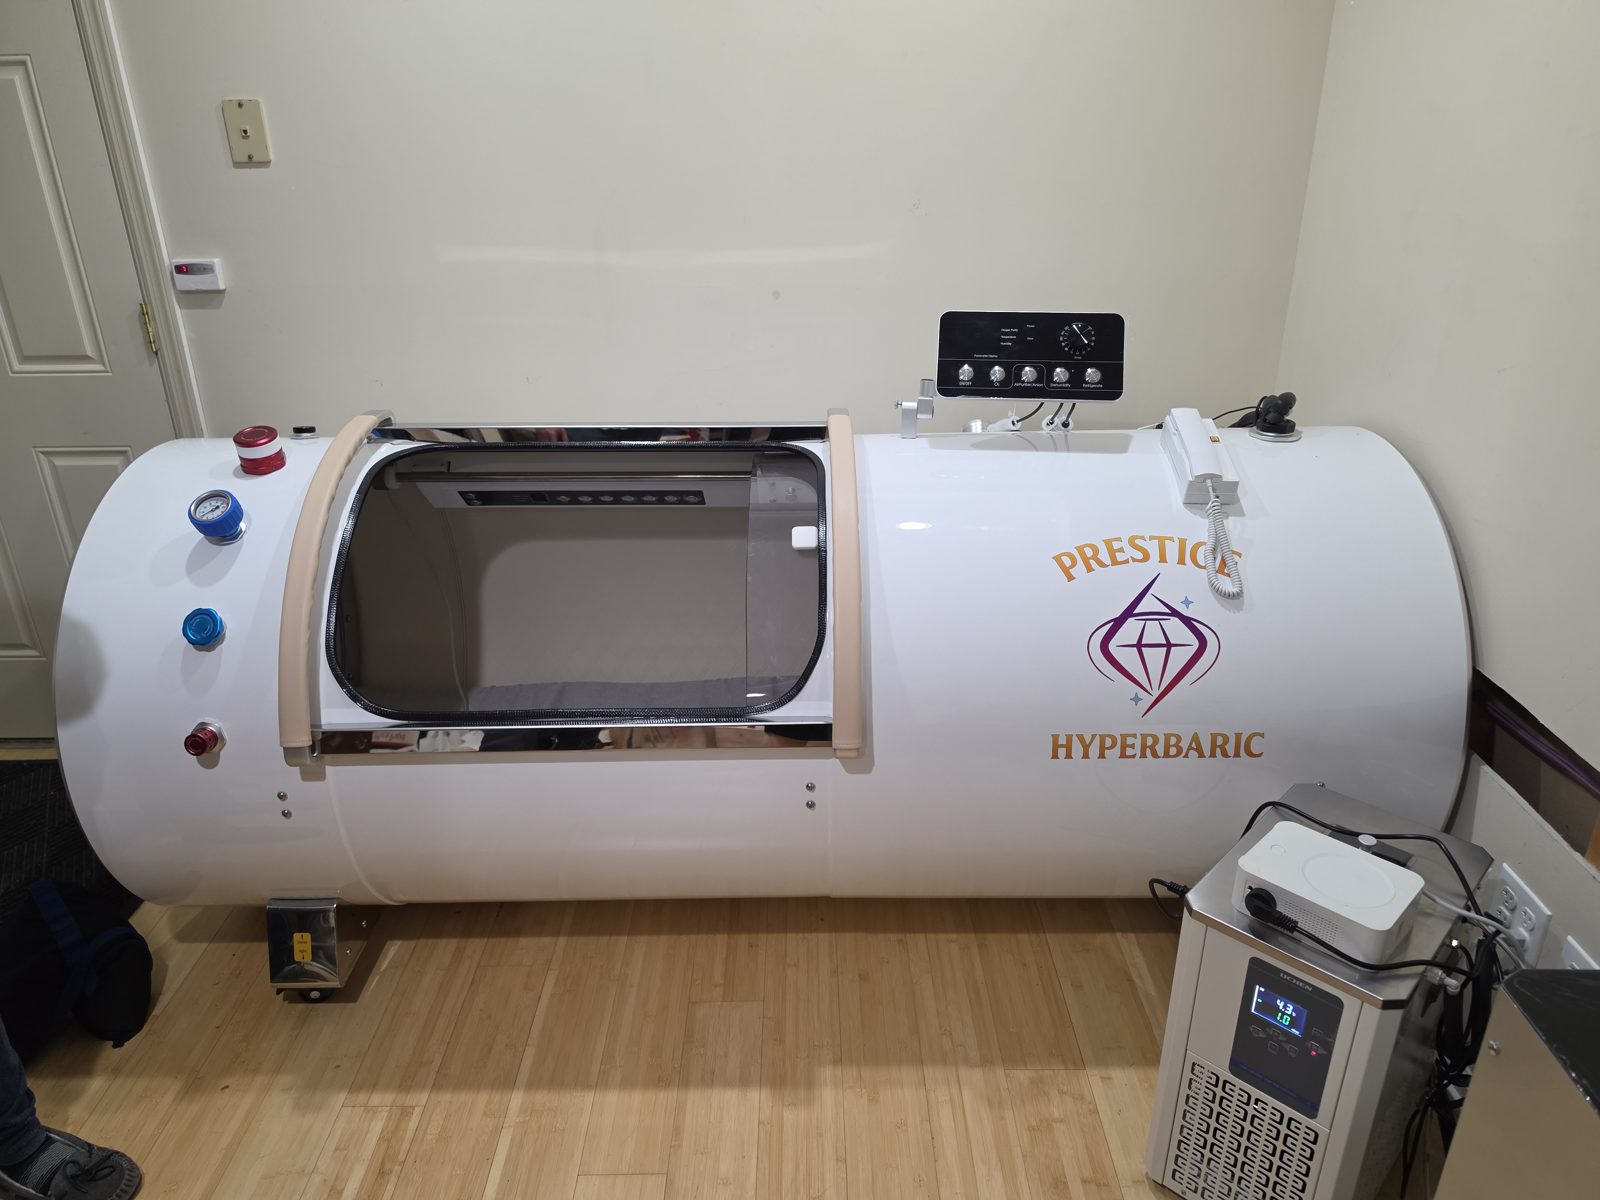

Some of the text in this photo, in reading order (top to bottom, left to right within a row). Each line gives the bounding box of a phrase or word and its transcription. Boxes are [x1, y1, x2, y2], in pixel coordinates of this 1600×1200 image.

[1050, 732, 1265, 760] HYPERBARIC
[1276, 999, 1294, 1015] 4.3
[1276, 1012, 1291, 1026] 1.0
